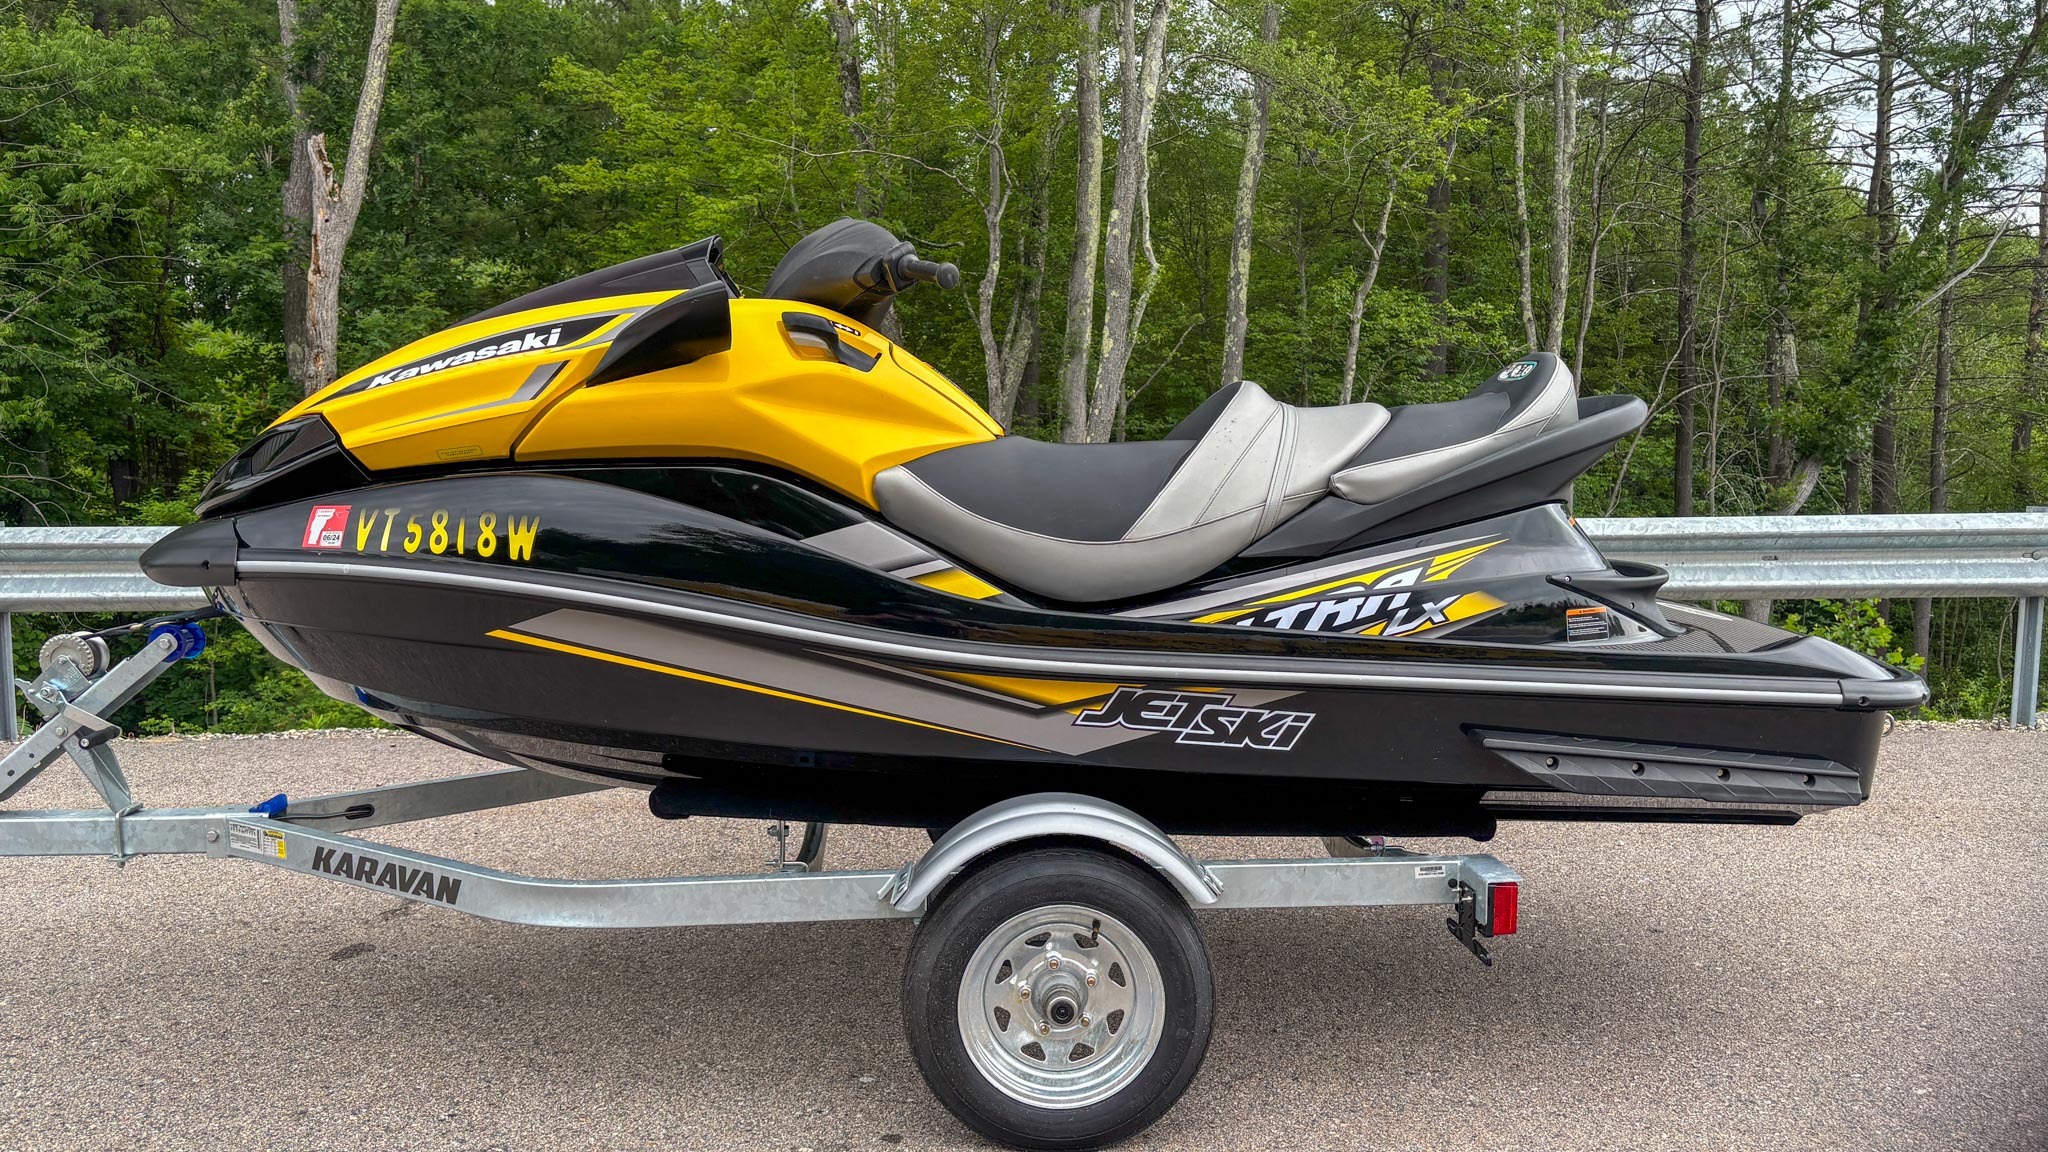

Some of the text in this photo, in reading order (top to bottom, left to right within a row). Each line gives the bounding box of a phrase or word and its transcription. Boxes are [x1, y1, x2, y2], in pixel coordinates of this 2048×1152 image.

[366, 327, 562, 390] Kawasaki
[322, 534, 341, 542] 06/24
[1382, 594, 1462, 636] LX
[1073, 685, 1235, 732] JET
[311, 845, 463, 905] KARAVAN
